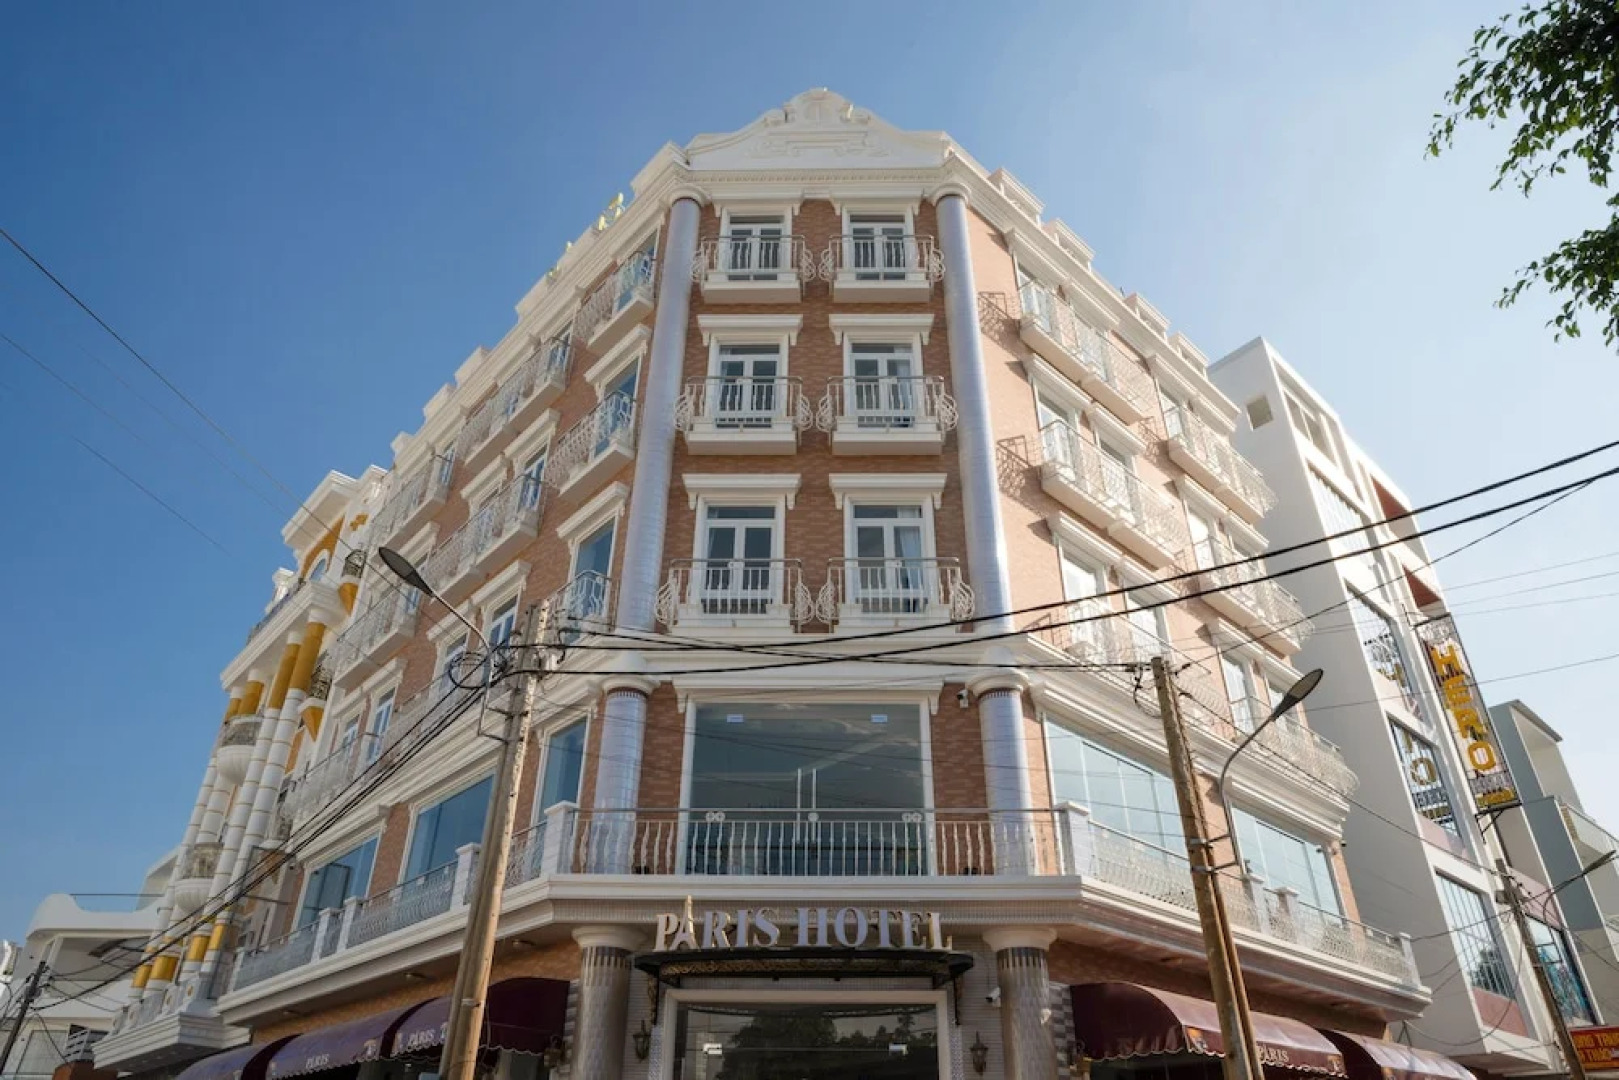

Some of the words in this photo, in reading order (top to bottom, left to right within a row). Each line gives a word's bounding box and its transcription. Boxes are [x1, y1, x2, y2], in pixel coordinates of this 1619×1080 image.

[654, 895, 780, 953] PARIS
[797, 907, 953, 951] HOTEL
[1257, 1046, 1290, 1063] PARIS
